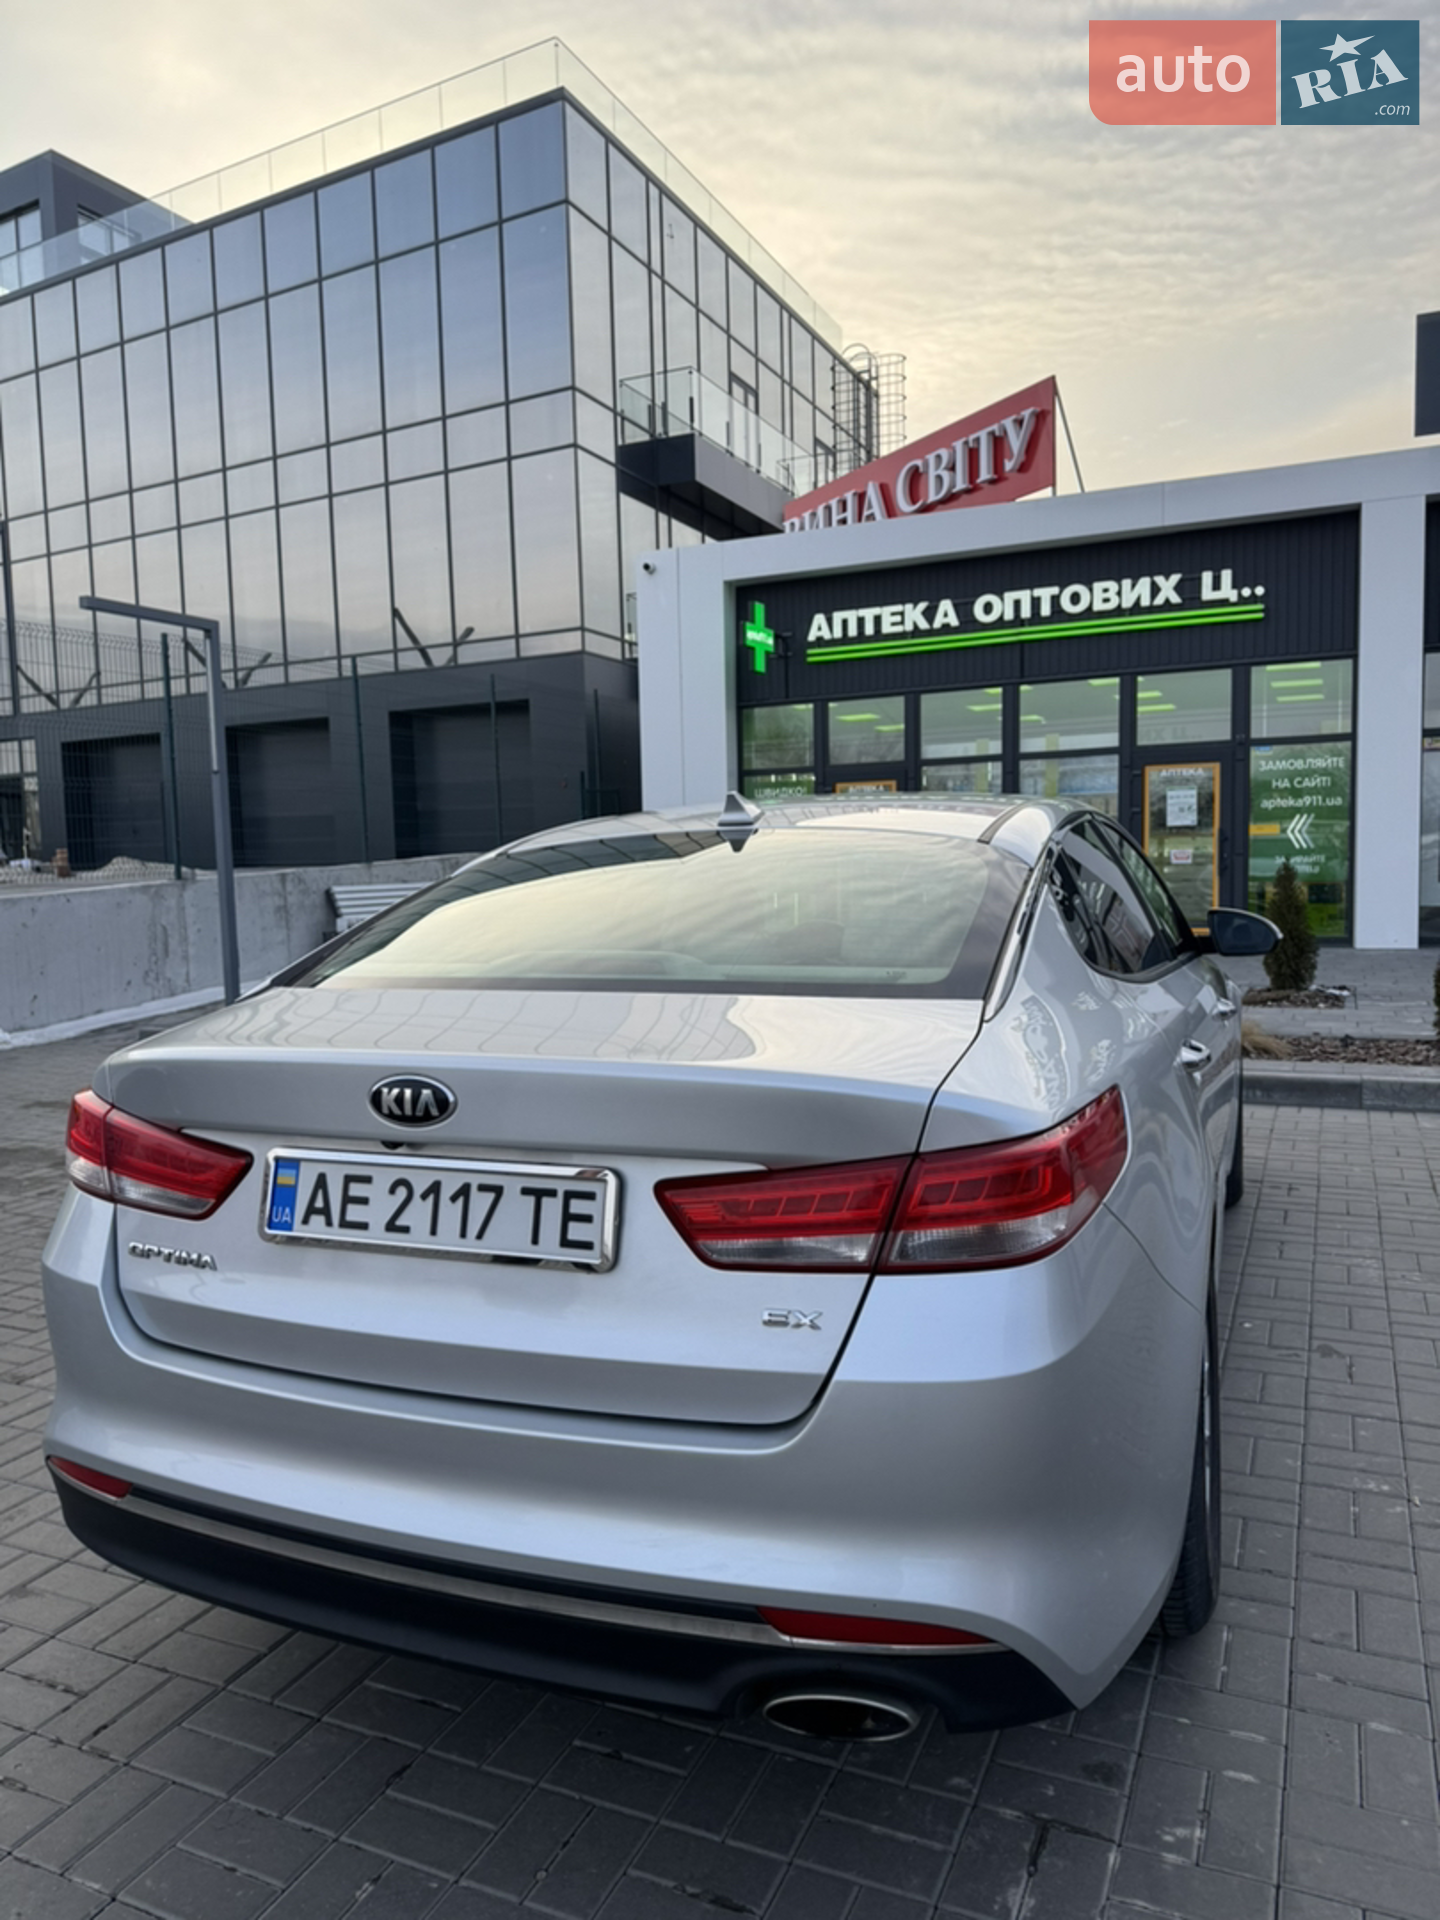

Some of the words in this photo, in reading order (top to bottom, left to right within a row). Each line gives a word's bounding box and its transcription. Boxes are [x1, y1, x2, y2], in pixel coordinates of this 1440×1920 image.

[895, 406, 1039, 513] СВІТУ
[807, 599, 960, 642] АПТЕКА
[973, 573, 1183, 624] ОПТОВИХ
[1258, 756, 1345, 771] ЗАМОВЛЯЙТЕ
[1271, 777, 1291, 789] НА
[1260, 795, 1343, 810] apteka911.ua
[380, 1086, 440, 1117] KIA
[271, 1206, 292, 1224] UA
[301, 1172, 374, 1231] AE
[384, 1178, 505, 1240] 2117
[519, 1186, 597, 1251] TE
[127, 1241, 218, 1272] OPTIMA
[762, 1308, 823, 1330] EX
